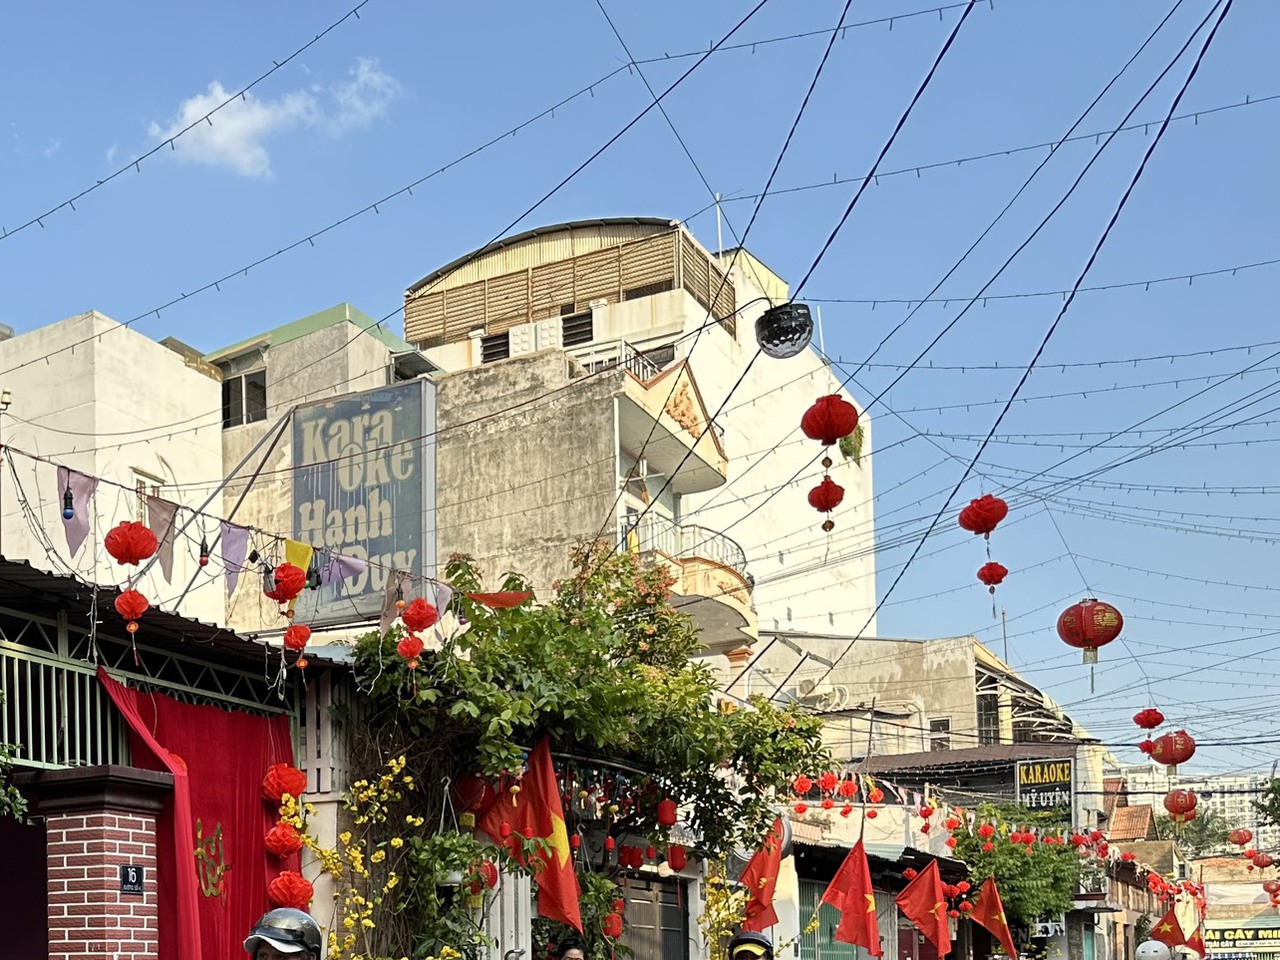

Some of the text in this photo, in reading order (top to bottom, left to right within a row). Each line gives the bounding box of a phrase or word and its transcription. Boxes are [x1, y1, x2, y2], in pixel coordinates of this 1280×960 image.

[301, 408, 395, 466] Kara
[1019, 763, 1071, 784] KARAOKE
[127, 867, 137, 883] 16
[1224, 928, 1255, 940] CÂY
